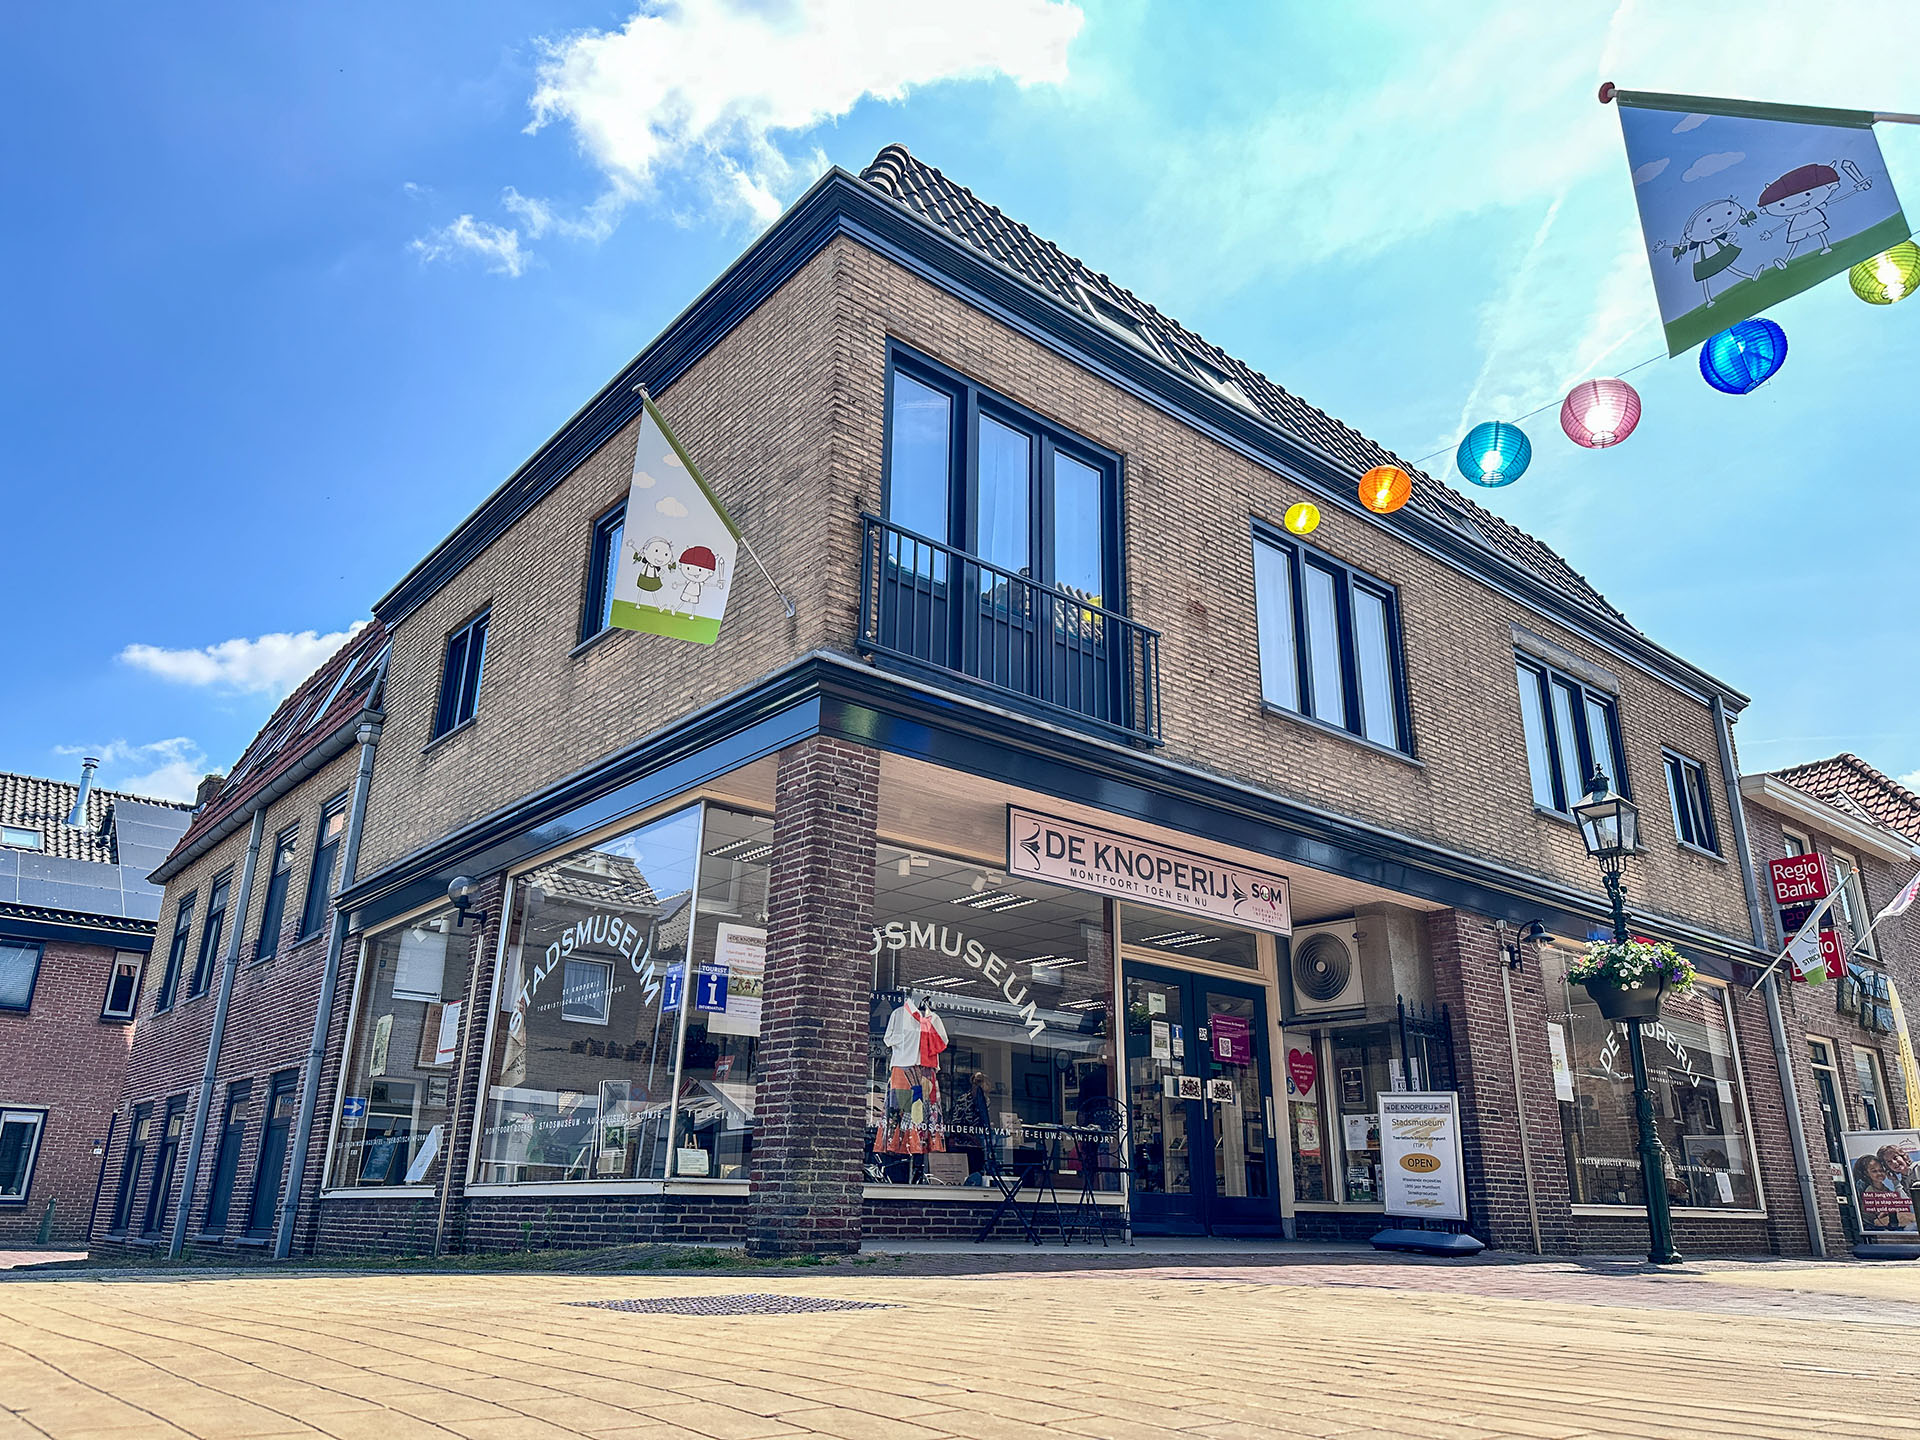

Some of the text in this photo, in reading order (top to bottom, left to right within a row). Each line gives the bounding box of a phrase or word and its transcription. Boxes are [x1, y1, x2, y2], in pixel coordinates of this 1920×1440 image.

[1045, 829, 1227, 898] DE KNOPERIJ
[1772, 859, 1818, 881] Regio
[1070, 868, 1207, 907] MONTFOORT TOEN EN NU
[1777, 878, 1819, 899] Bank
[509, 914, 661, 1037] STADSMUSEUM
[701, 965, 728, 974] TOURIST
[869, 920, 1047, 1040] SMUSEUM
[1600, 1029, 1620, 1074] DE
[538, 1118, 581, 1130] STADSMUSEUM
[994, 1127, 1011, 1137] VAN
[1391, 1118, 1445, 1127] Stadsmuseum
[1407, 1158, 1433, 1168] OPEN
